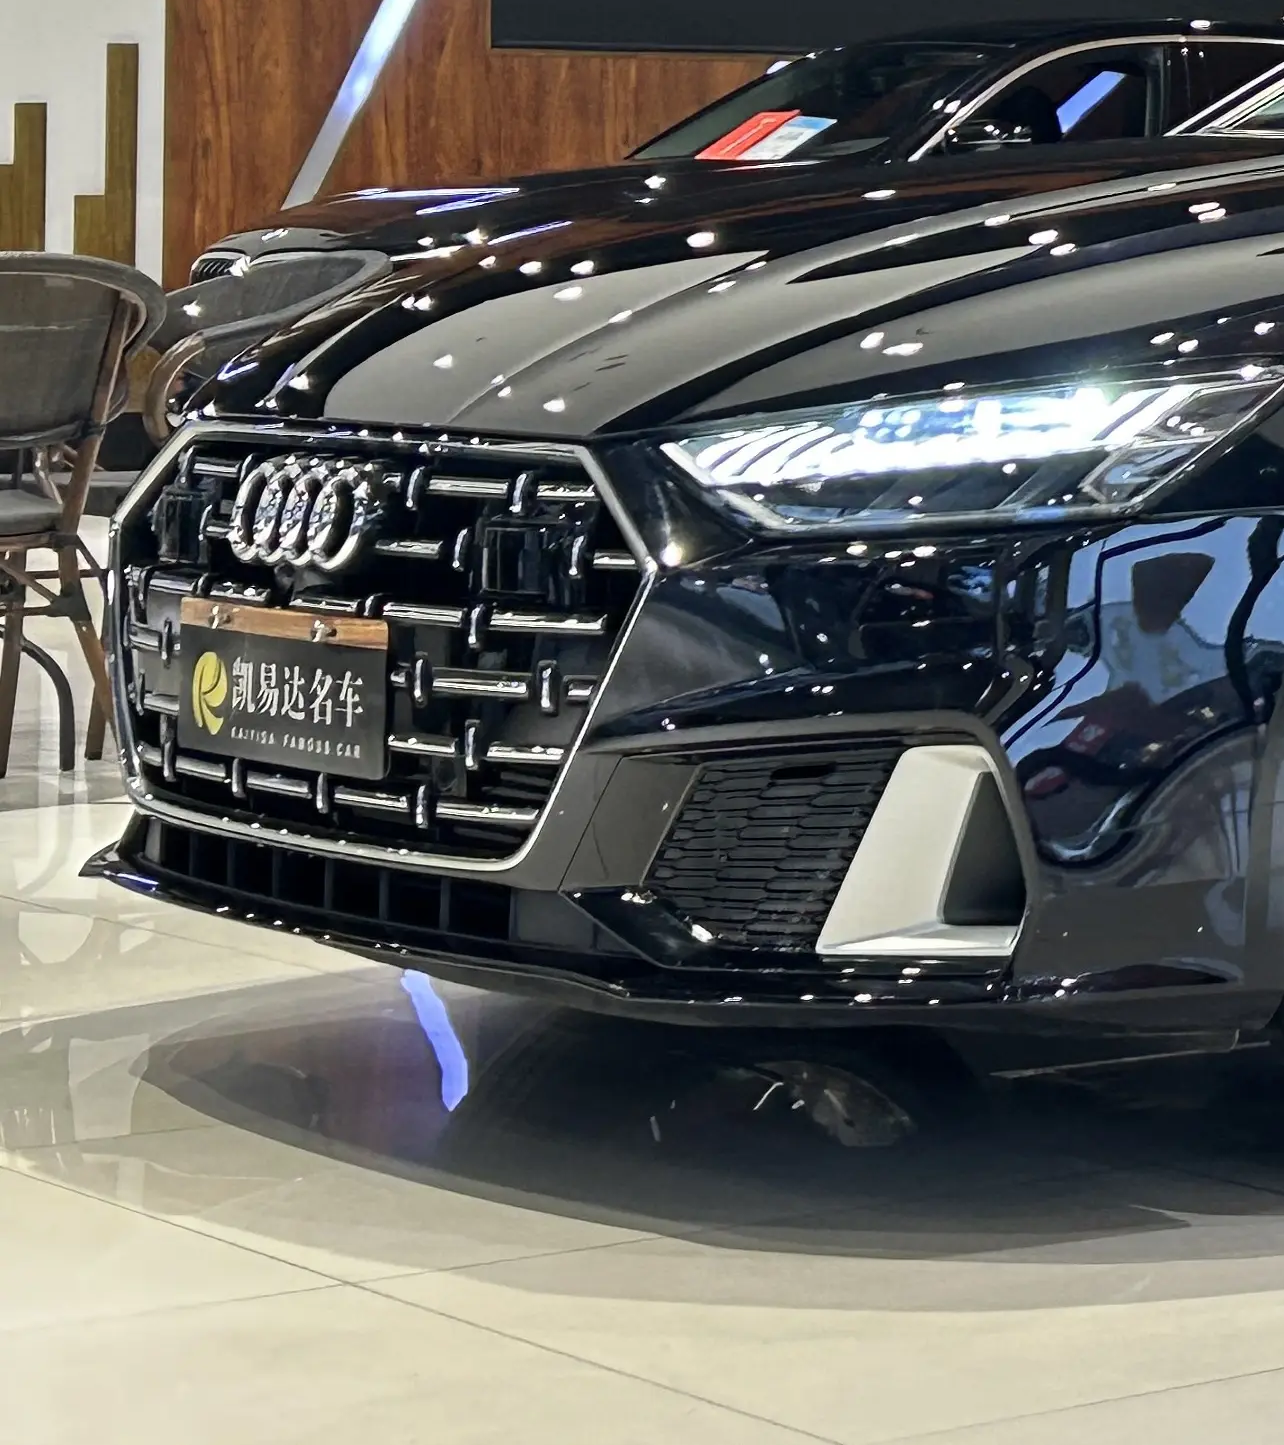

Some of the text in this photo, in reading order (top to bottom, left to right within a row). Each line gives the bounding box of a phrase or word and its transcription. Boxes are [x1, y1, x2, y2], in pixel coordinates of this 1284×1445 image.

[231, 656, 364, 727] 凯易达名车
[336, 742, 361, 759] CAR
